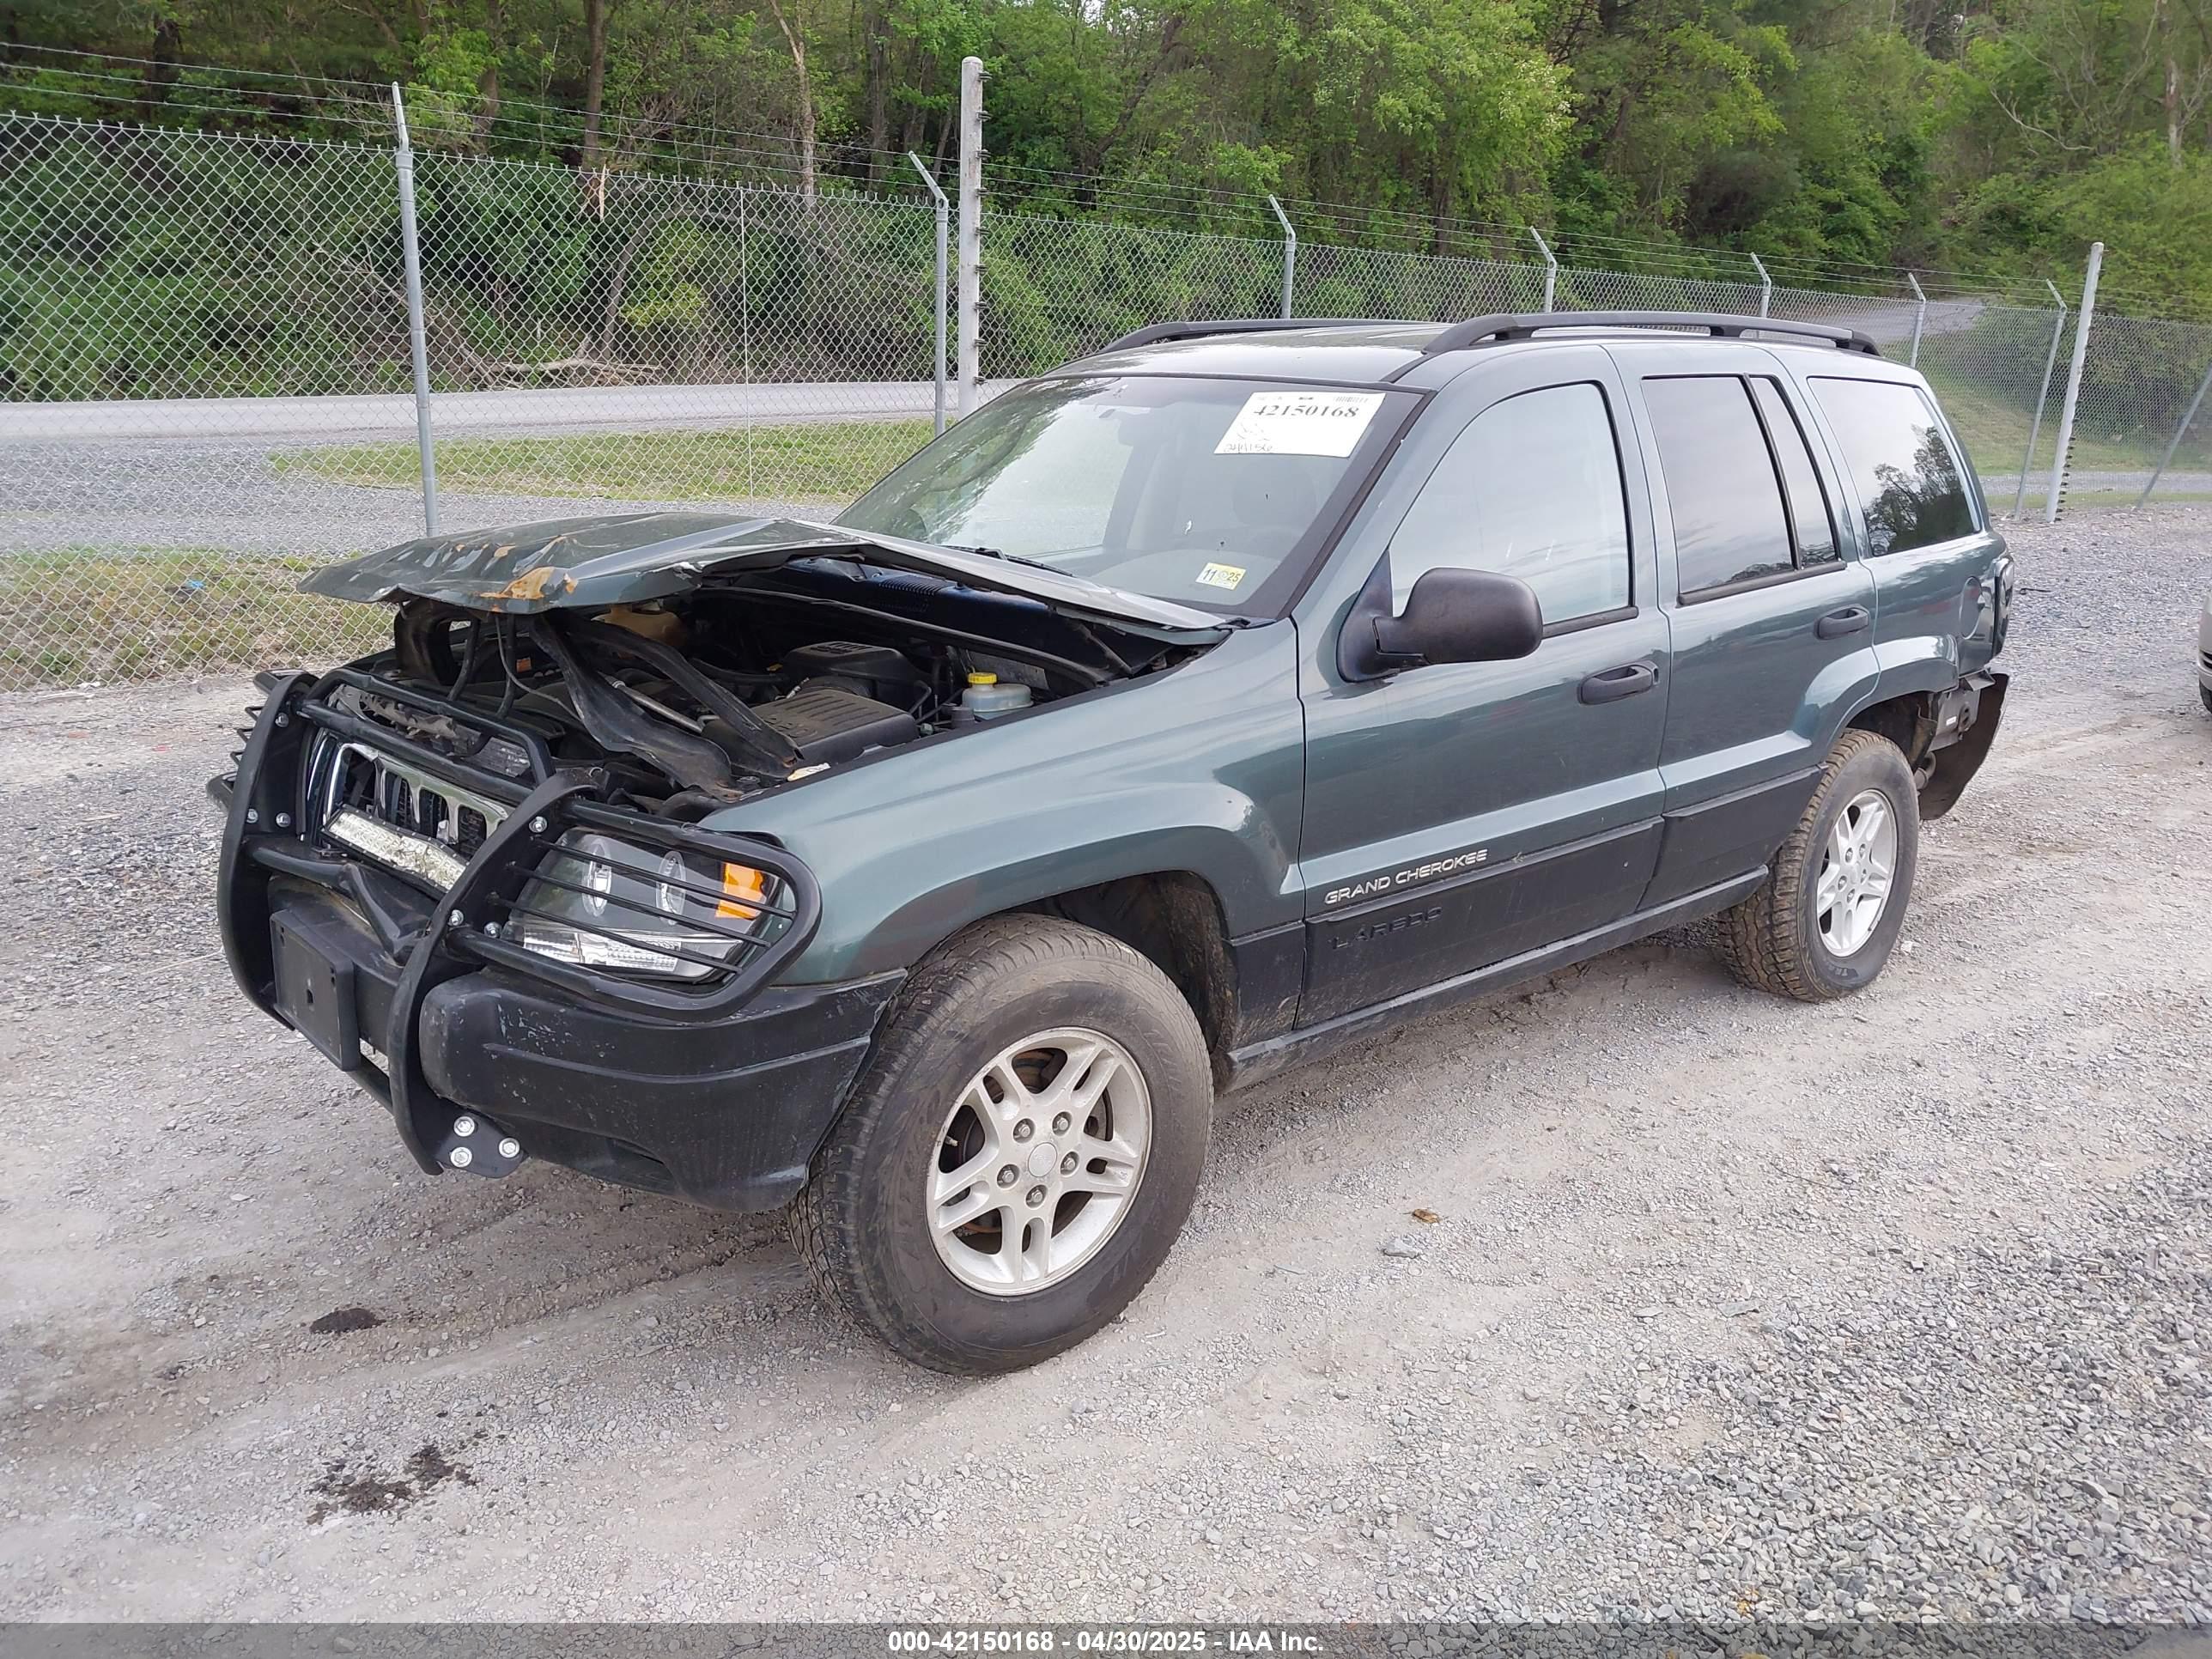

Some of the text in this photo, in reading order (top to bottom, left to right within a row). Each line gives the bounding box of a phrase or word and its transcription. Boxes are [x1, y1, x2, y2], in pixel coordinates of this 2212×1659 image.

[1254, 405, 1359, 417] 42150168
[1203, 568, 1242, 582] 11 25
[1324, 848, 1488, 904] GRAND CHEROKEE
